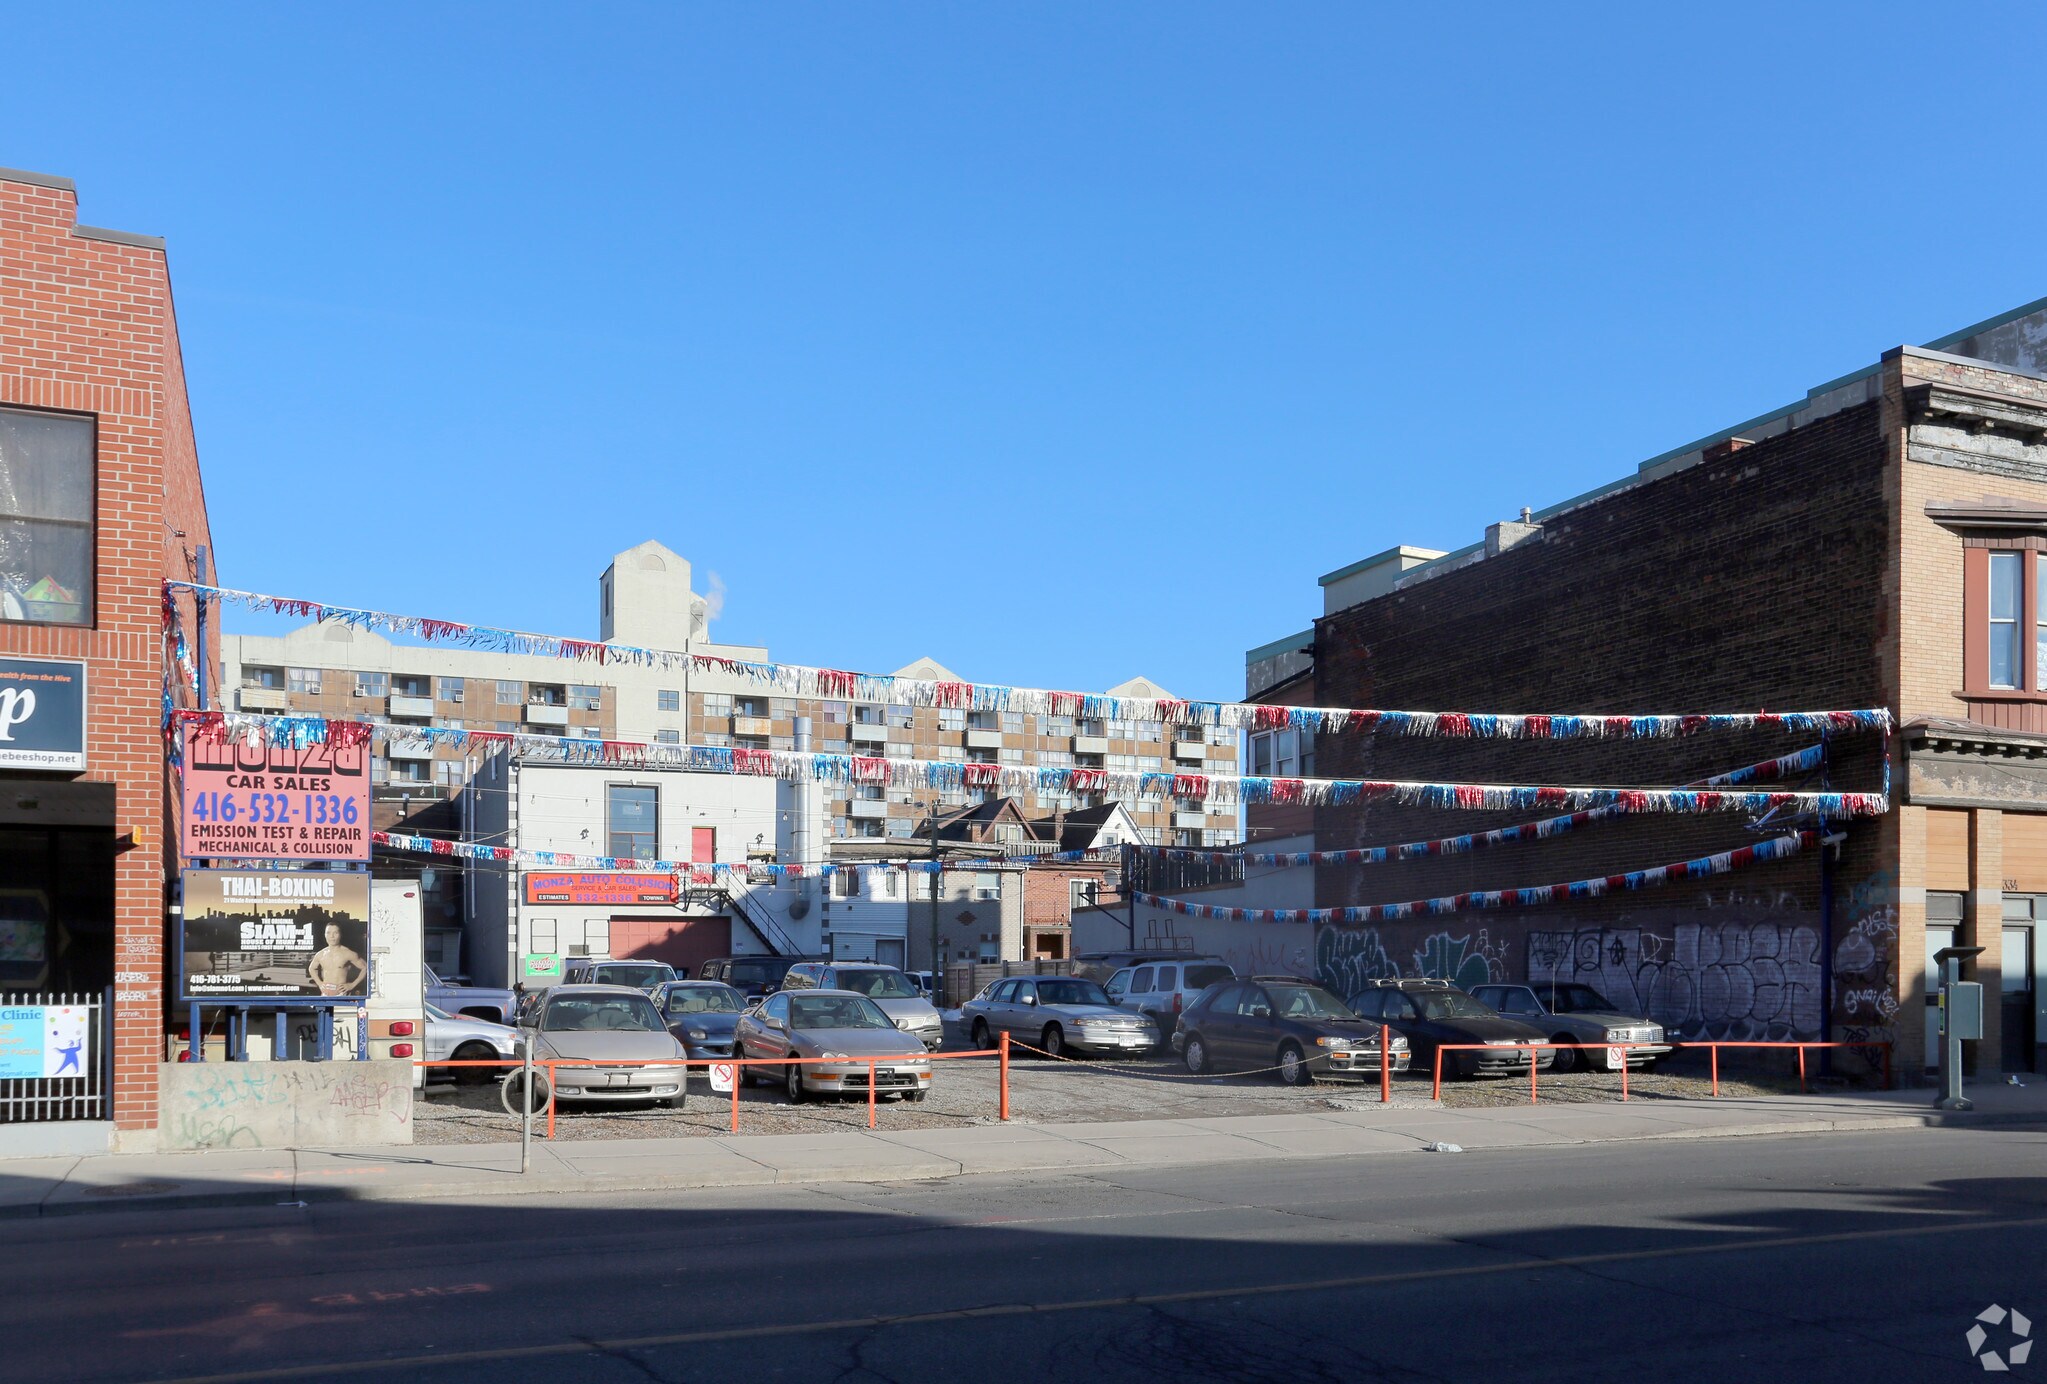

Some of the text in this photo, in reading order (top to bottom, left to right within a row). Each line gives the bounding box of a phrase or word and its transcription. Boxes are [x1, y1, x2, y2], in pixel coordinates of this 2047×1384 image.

[19, 672, 39, 681] from
[226, 775, 331, 792] CAR SALES
[192, 792, 358, 825] 416-532-1336
[192, 825, 362, 840] EMISSION TEST & REPAIR
[198, 841, 353, 854] MECHANICAL & COLLISION
[221, 876, 335, 897] THAI-BOXING
[533, 875, 676, 890] MONZA AUTO COLLISION
[576, 893, 632, 902] 532-1336
[190, 975, 241, 984] 416-781-3775
[2, 1010, 42, 1020] Clinic
